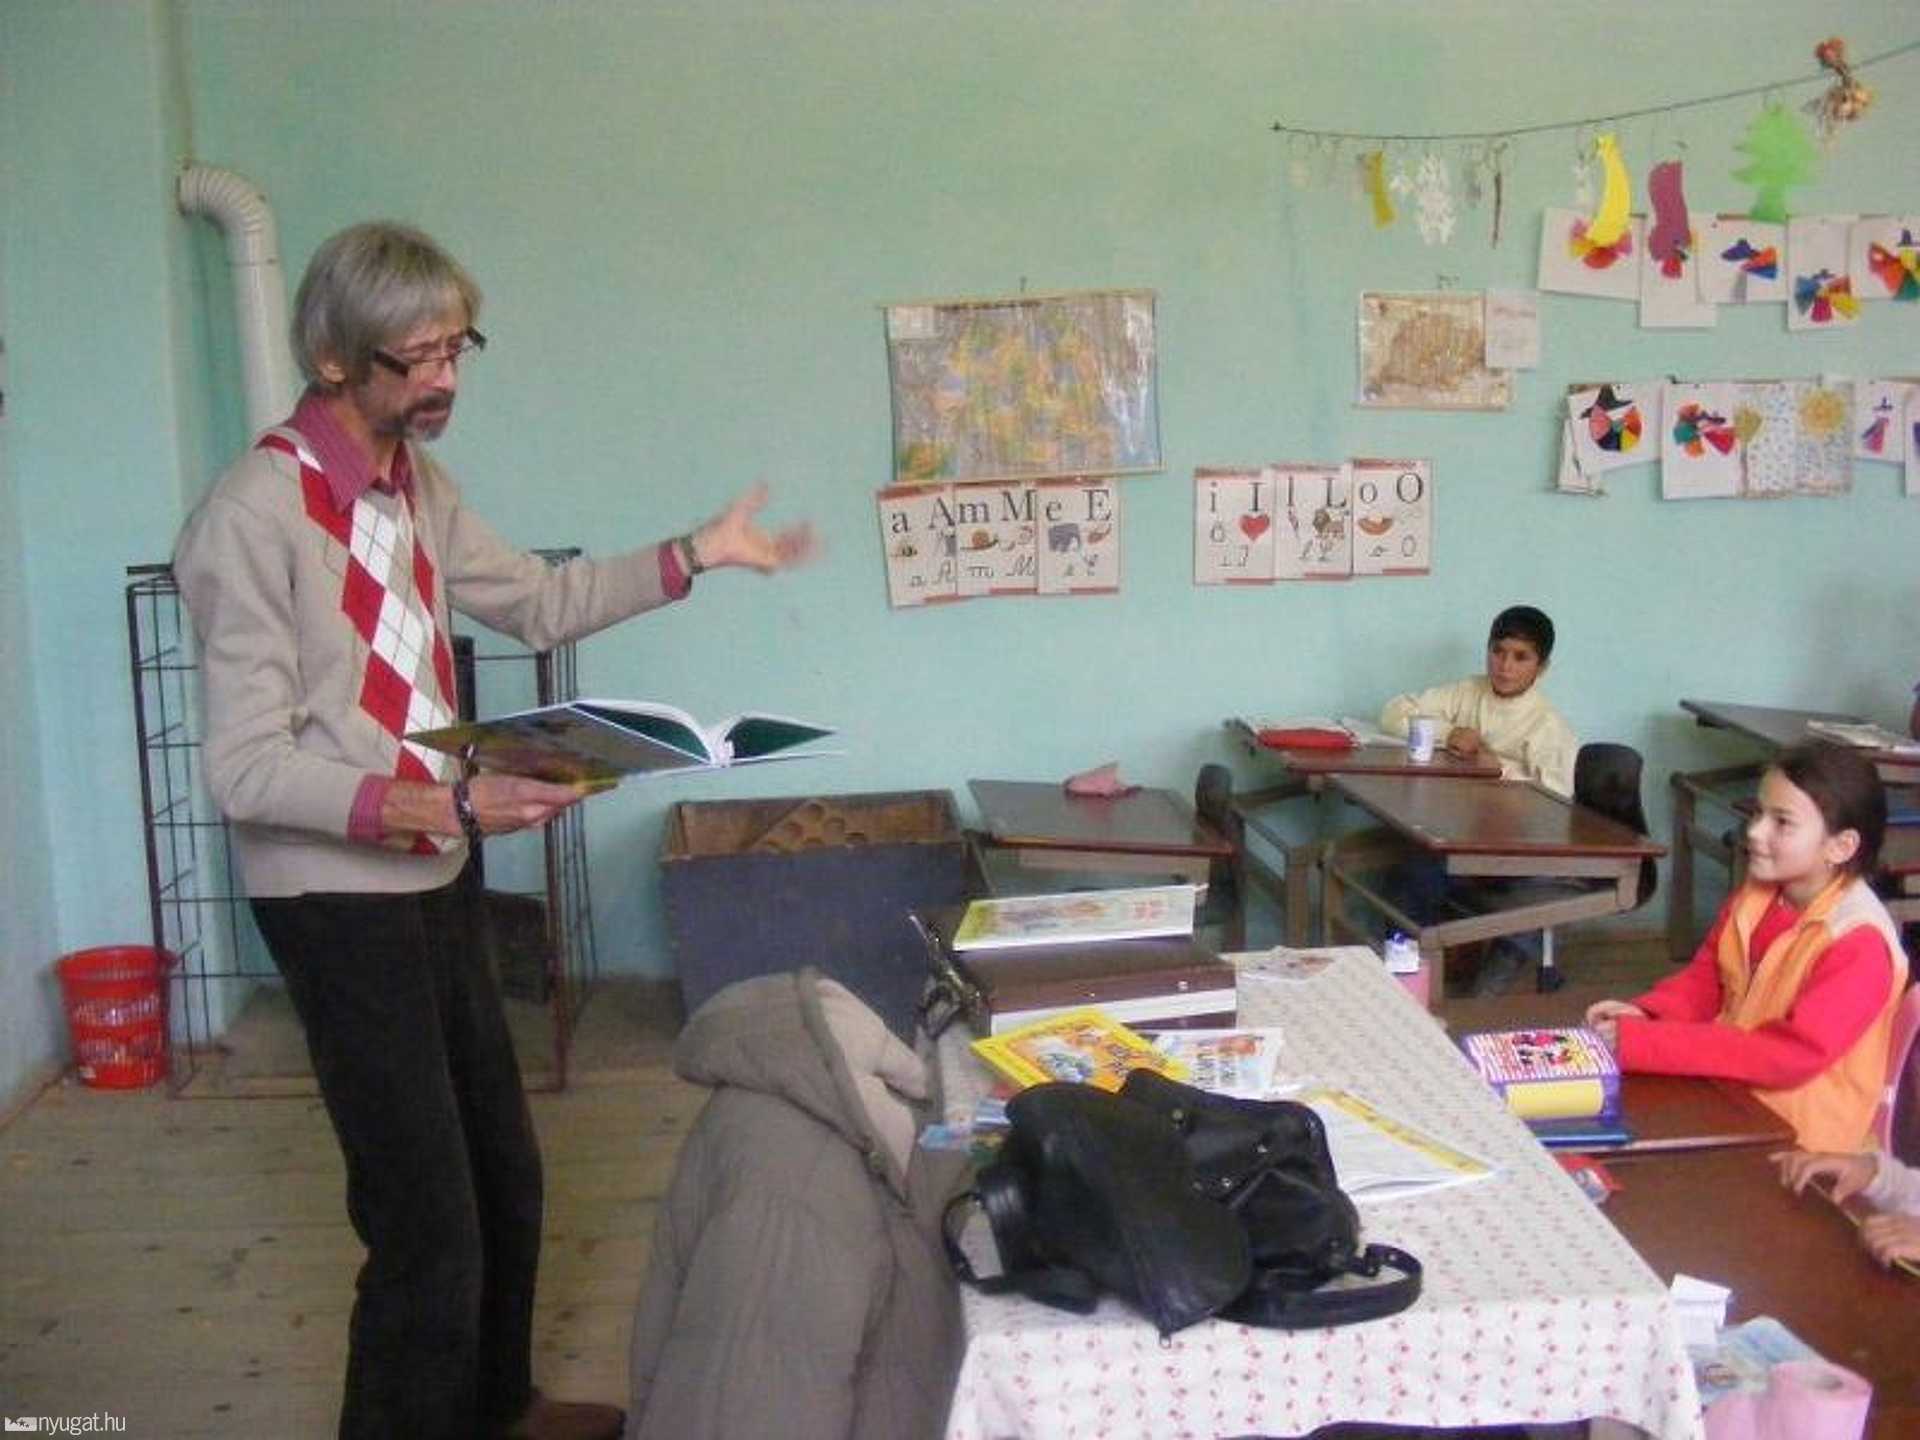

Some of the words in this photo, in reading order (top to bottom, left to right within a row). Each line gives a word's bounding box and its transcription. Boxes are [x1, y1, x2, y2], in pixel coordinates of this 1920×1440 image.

[1209, 481, 1217, 512] i
[1249, 482, 1267, 512] I
[1325, 477, 1346, 508] L
[1396, 472, 1424, 504] O
[891, 511, 910, 534] a
[929, 496, 956, 530] A
[959, 501, 990, 524] m
[1001, 489, 1036, 522] M
[1046, 501, 1062, 521] e
[1081, 489, 1112, 521] E
